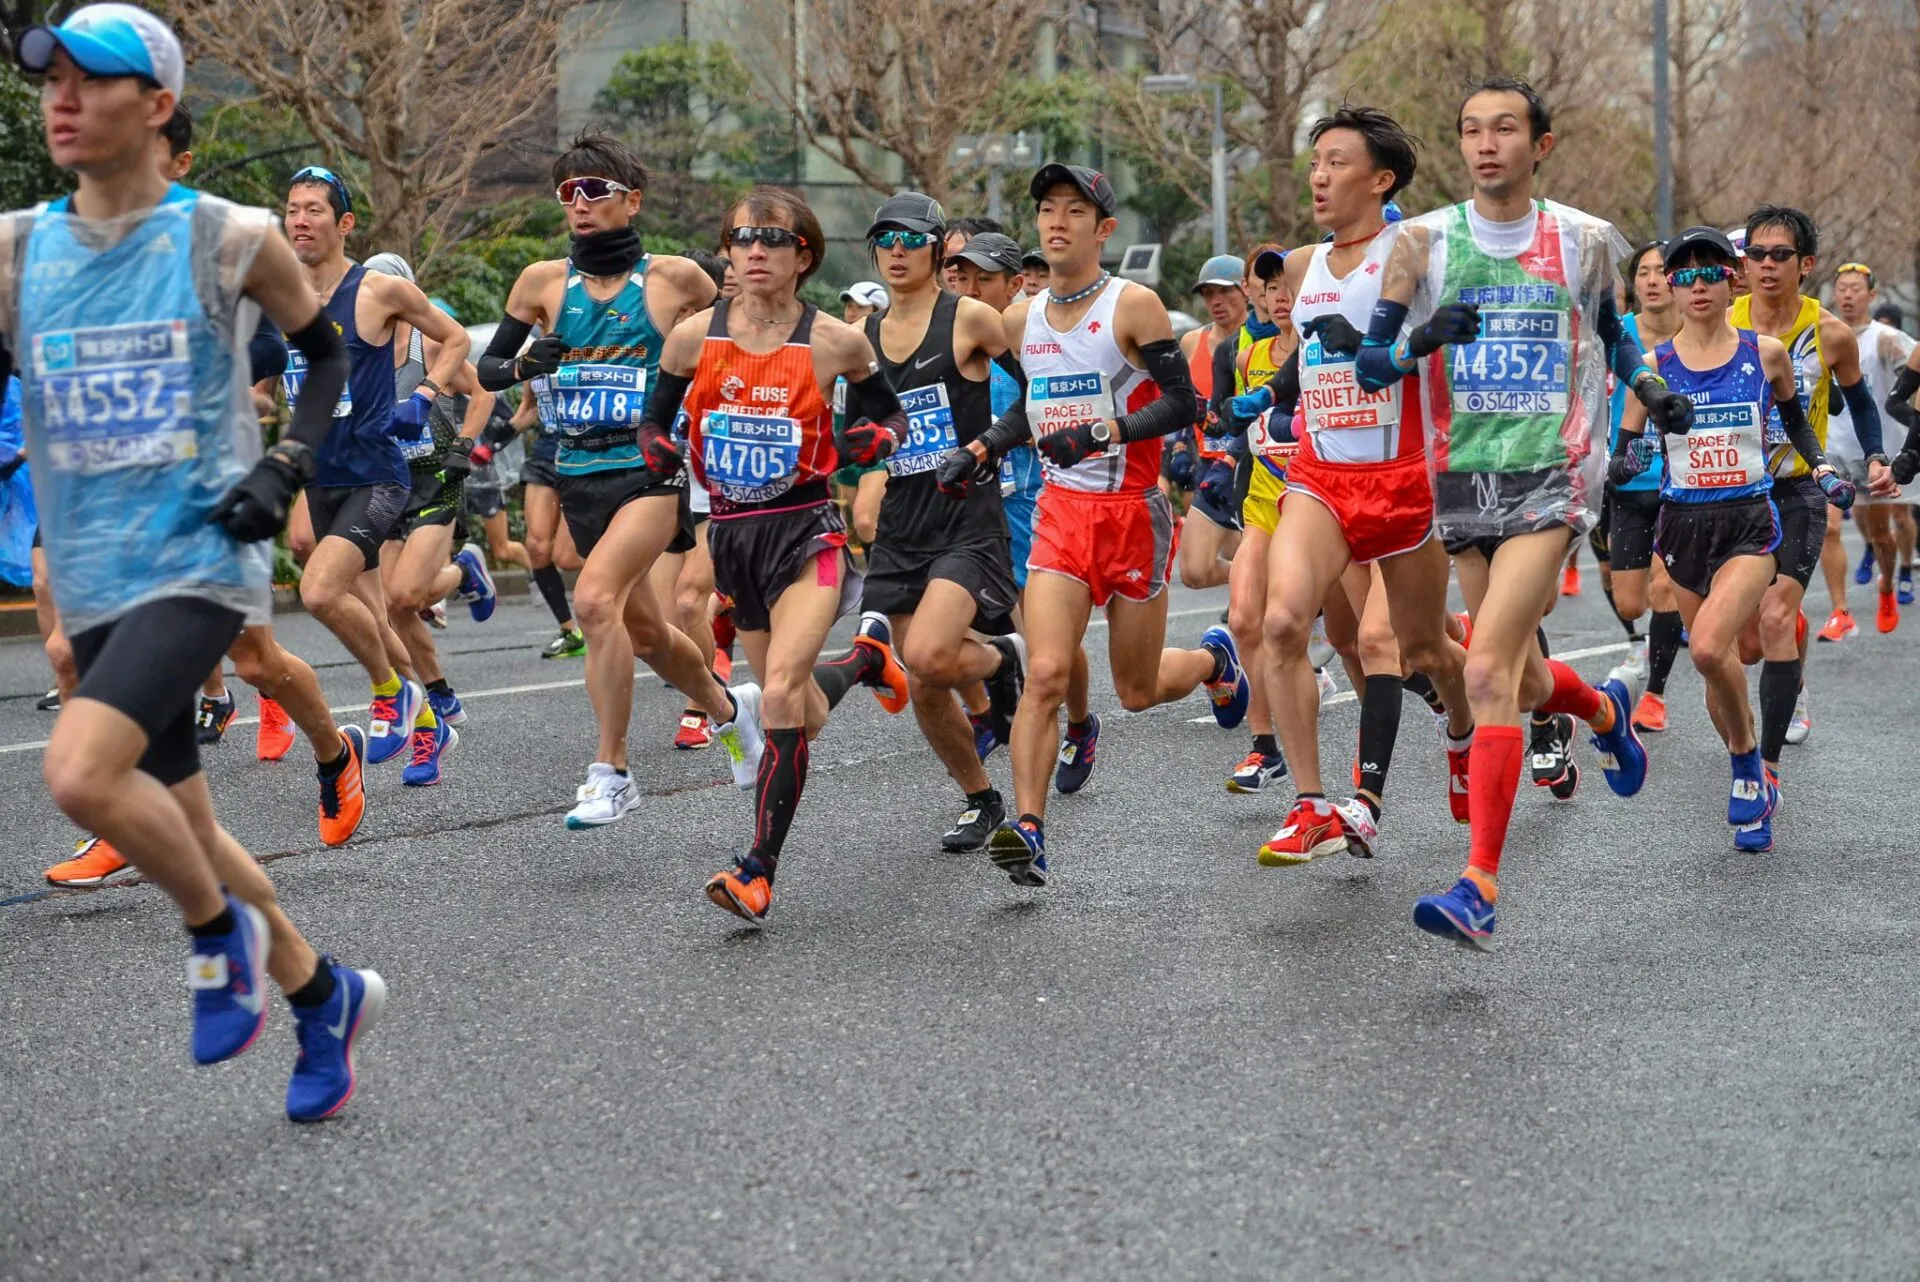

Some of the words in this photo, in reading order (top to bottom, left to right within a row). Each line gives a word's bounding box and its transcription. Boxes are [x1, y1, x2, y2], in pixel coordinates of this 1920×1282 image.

[1459, 285, 1556, 304] 長府製作所
[1490, 318, 1553, 332] 東京メトロ
[1453, 343, 1549, 381] A4352
[580, 371, 634, 383] 東京メトロ
[1318, 370, 1353, 385] PACE
[1050, 378, 1097, 393] 東京メトロ
[43, 369, 167, 428] A4552
[751, 386, 789, 402] FUSE
[1304, 386, 1392, 410] TSUETAKI
[556, 391, 628, 422] A4618
[719, 403, 763, 416] ATHLETIC
[1045, 404, 1077, 418] PACE
[1080, 403, 1093, 416] 23
[1330, 412, 1375, 424] ヤマザキ
[1695, 411, 1748, 424] 東京メトロ
[731, 421, 789, 437] 東京メトロ
[1688, 435, 1725, 449] PACE
[1728, 433, 1741, 446] 27
[705, 439, 785, 480] A4705
[1689, 448, 1739, 469] SATO
[1700, 473, 1744, 485] ヤマザキ
